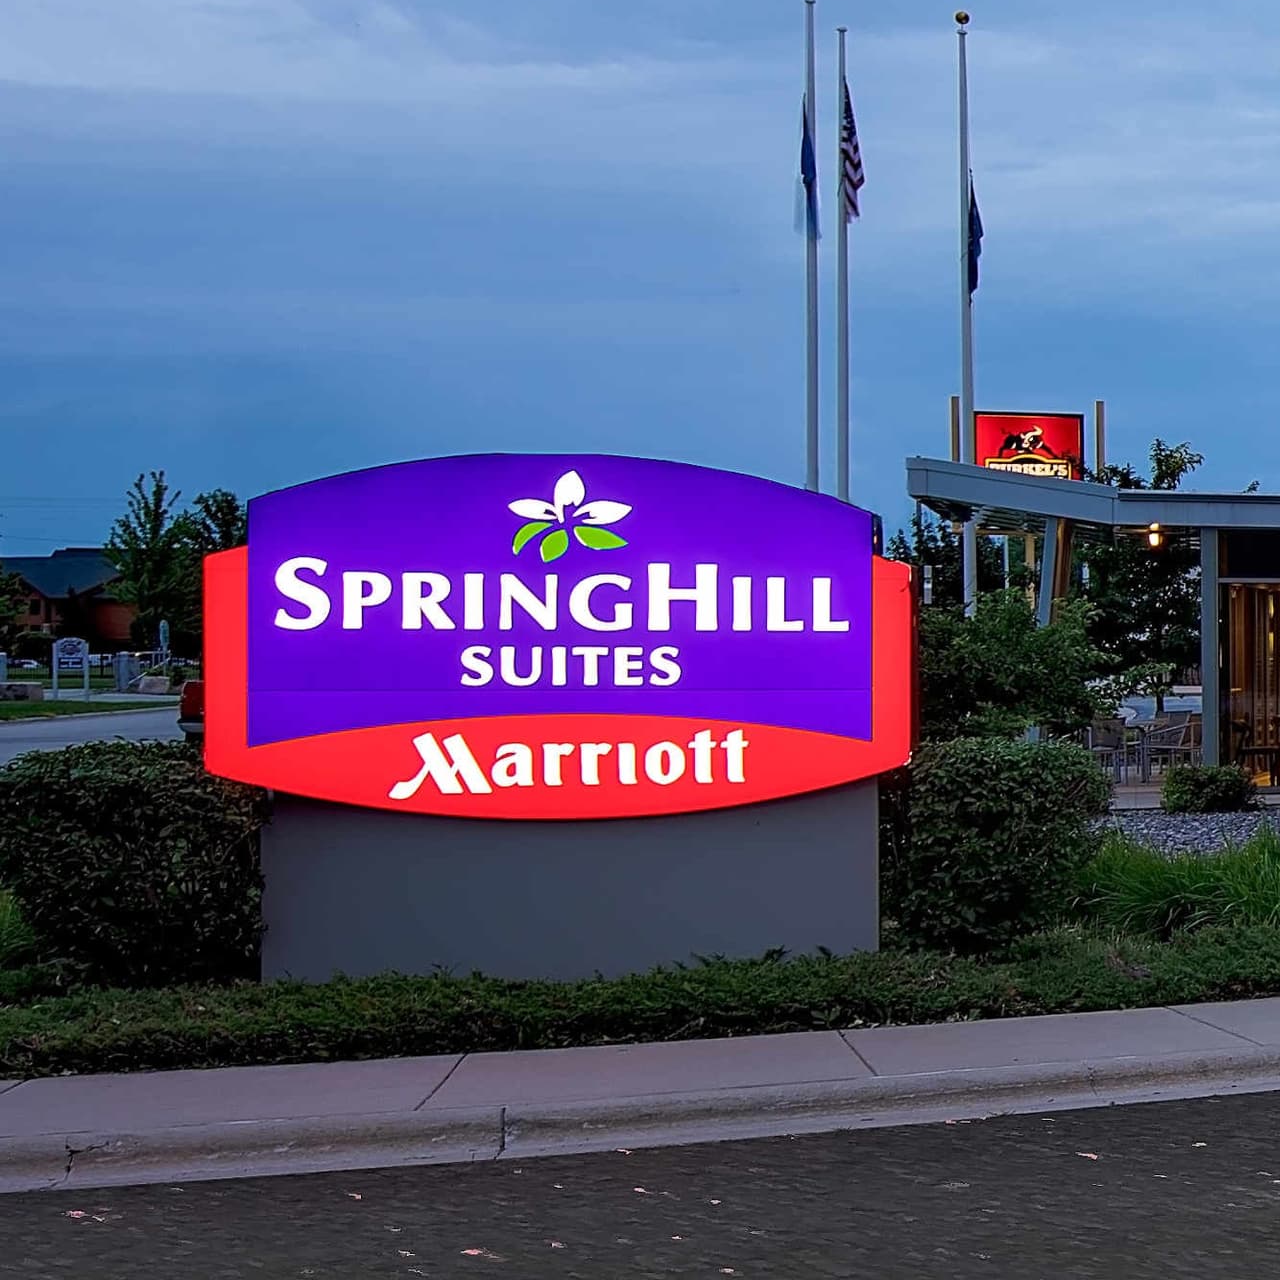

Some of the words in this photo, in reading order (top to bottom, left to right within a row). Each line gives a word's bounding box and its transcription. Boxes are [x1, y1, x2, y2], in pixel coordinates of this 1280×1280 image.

[273, 555, 851, 633] SPRINGHILL
[459, 644, 683, 687] SUITES
[387, 728, 750, 801] Marriott
